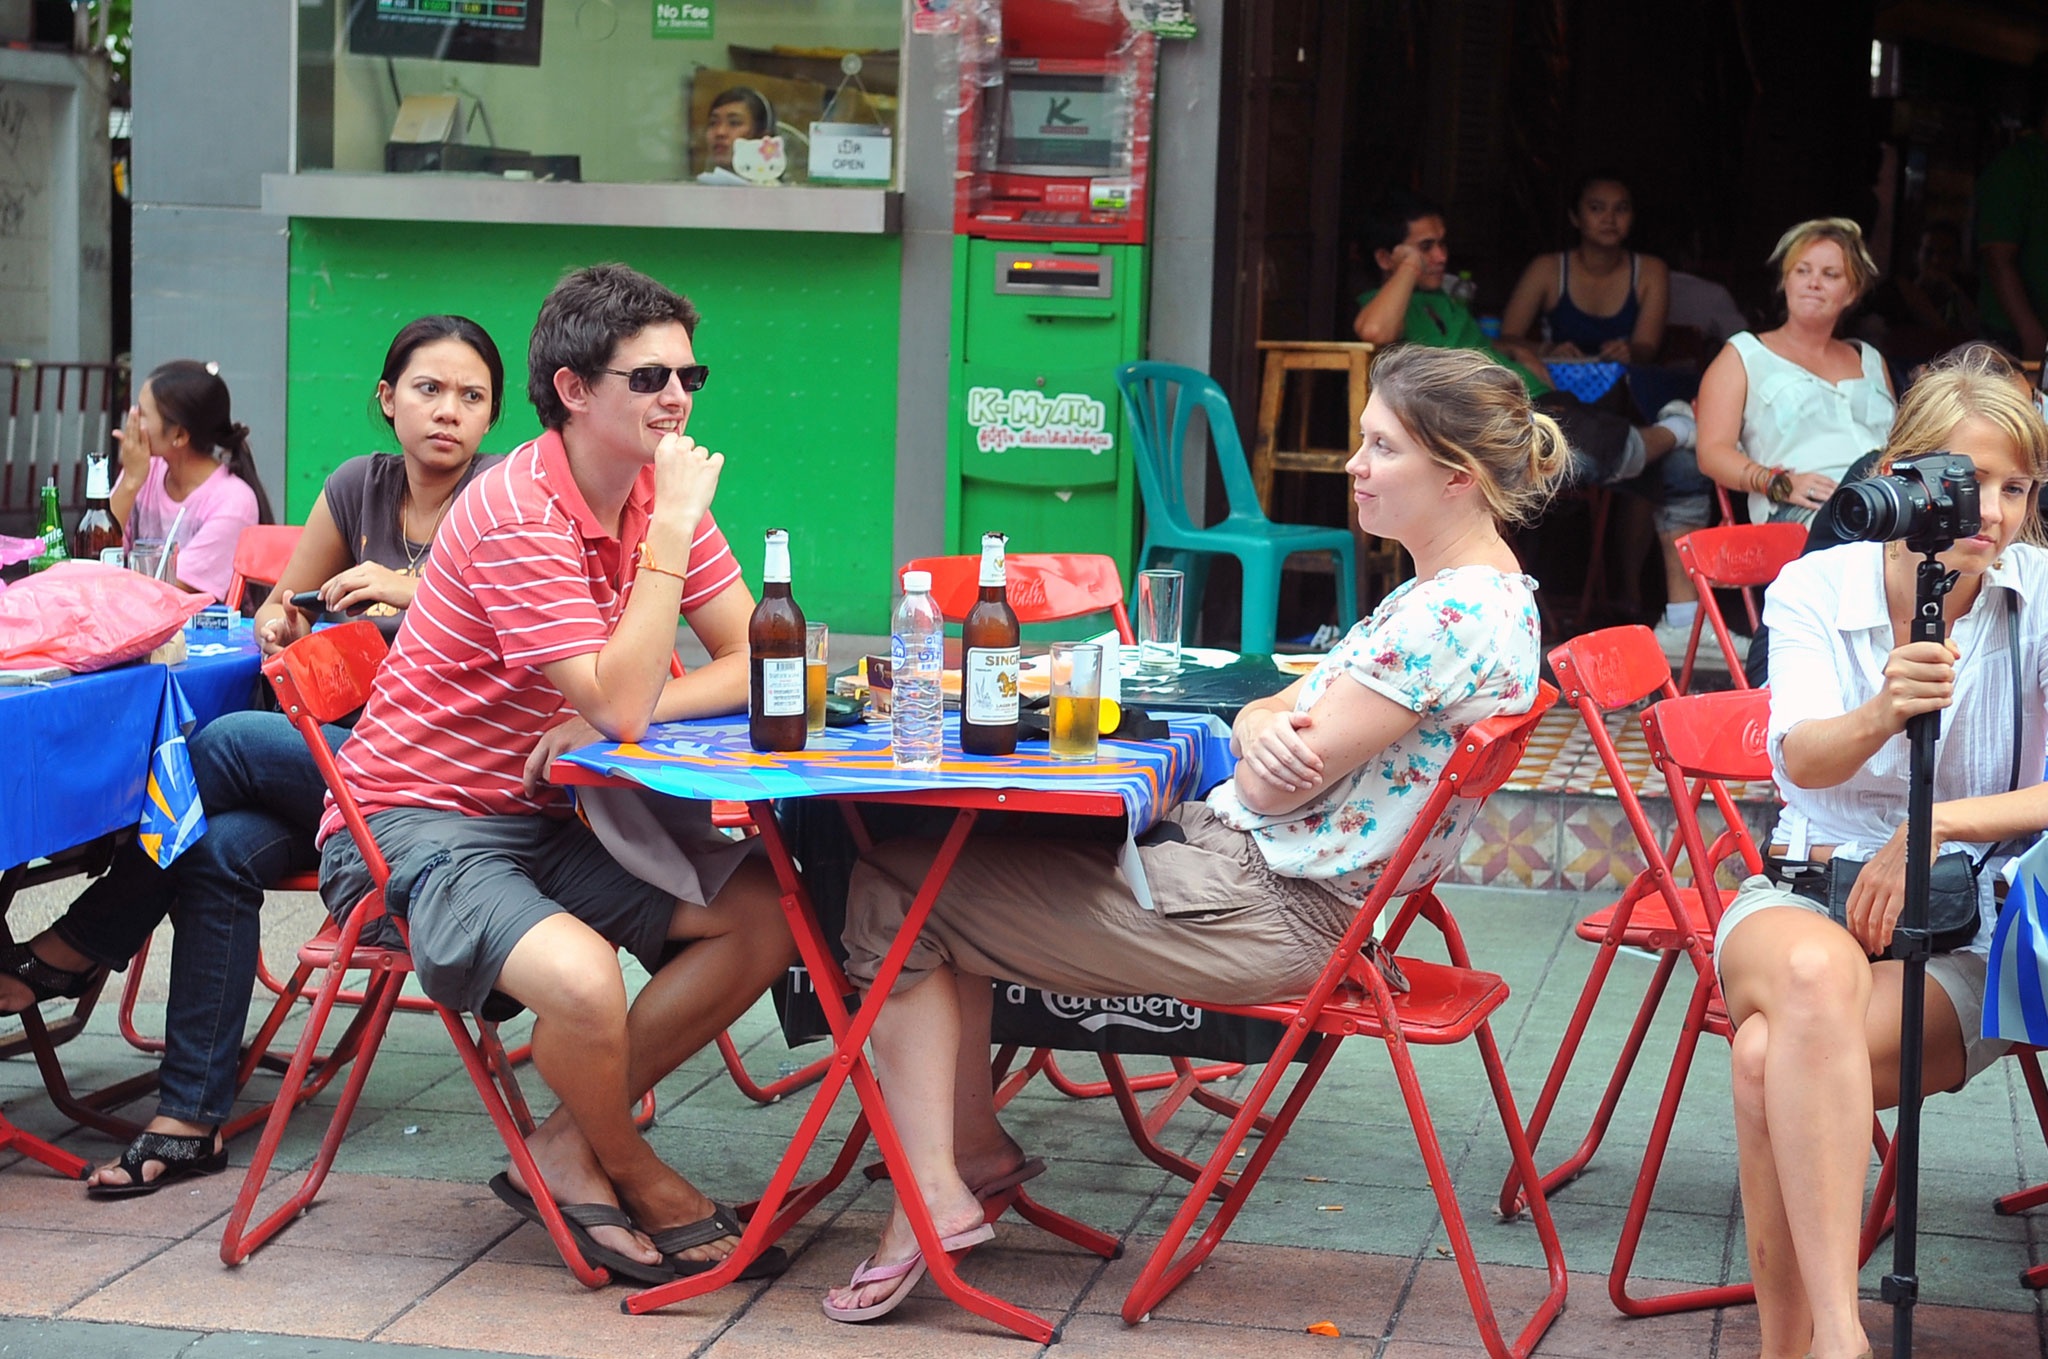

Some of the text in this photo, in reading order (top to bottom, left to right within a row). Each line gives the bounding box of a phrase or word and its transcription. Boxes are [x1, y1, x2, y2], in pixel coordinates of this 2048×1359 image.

[657, 4, 709, 19] No Fee
[1045, 96, 1086, 126] K
[832, 159, 866, 170] OPEN
[36, 528, 64, 545] rite
[1006, 984, 1026, 1004] a
